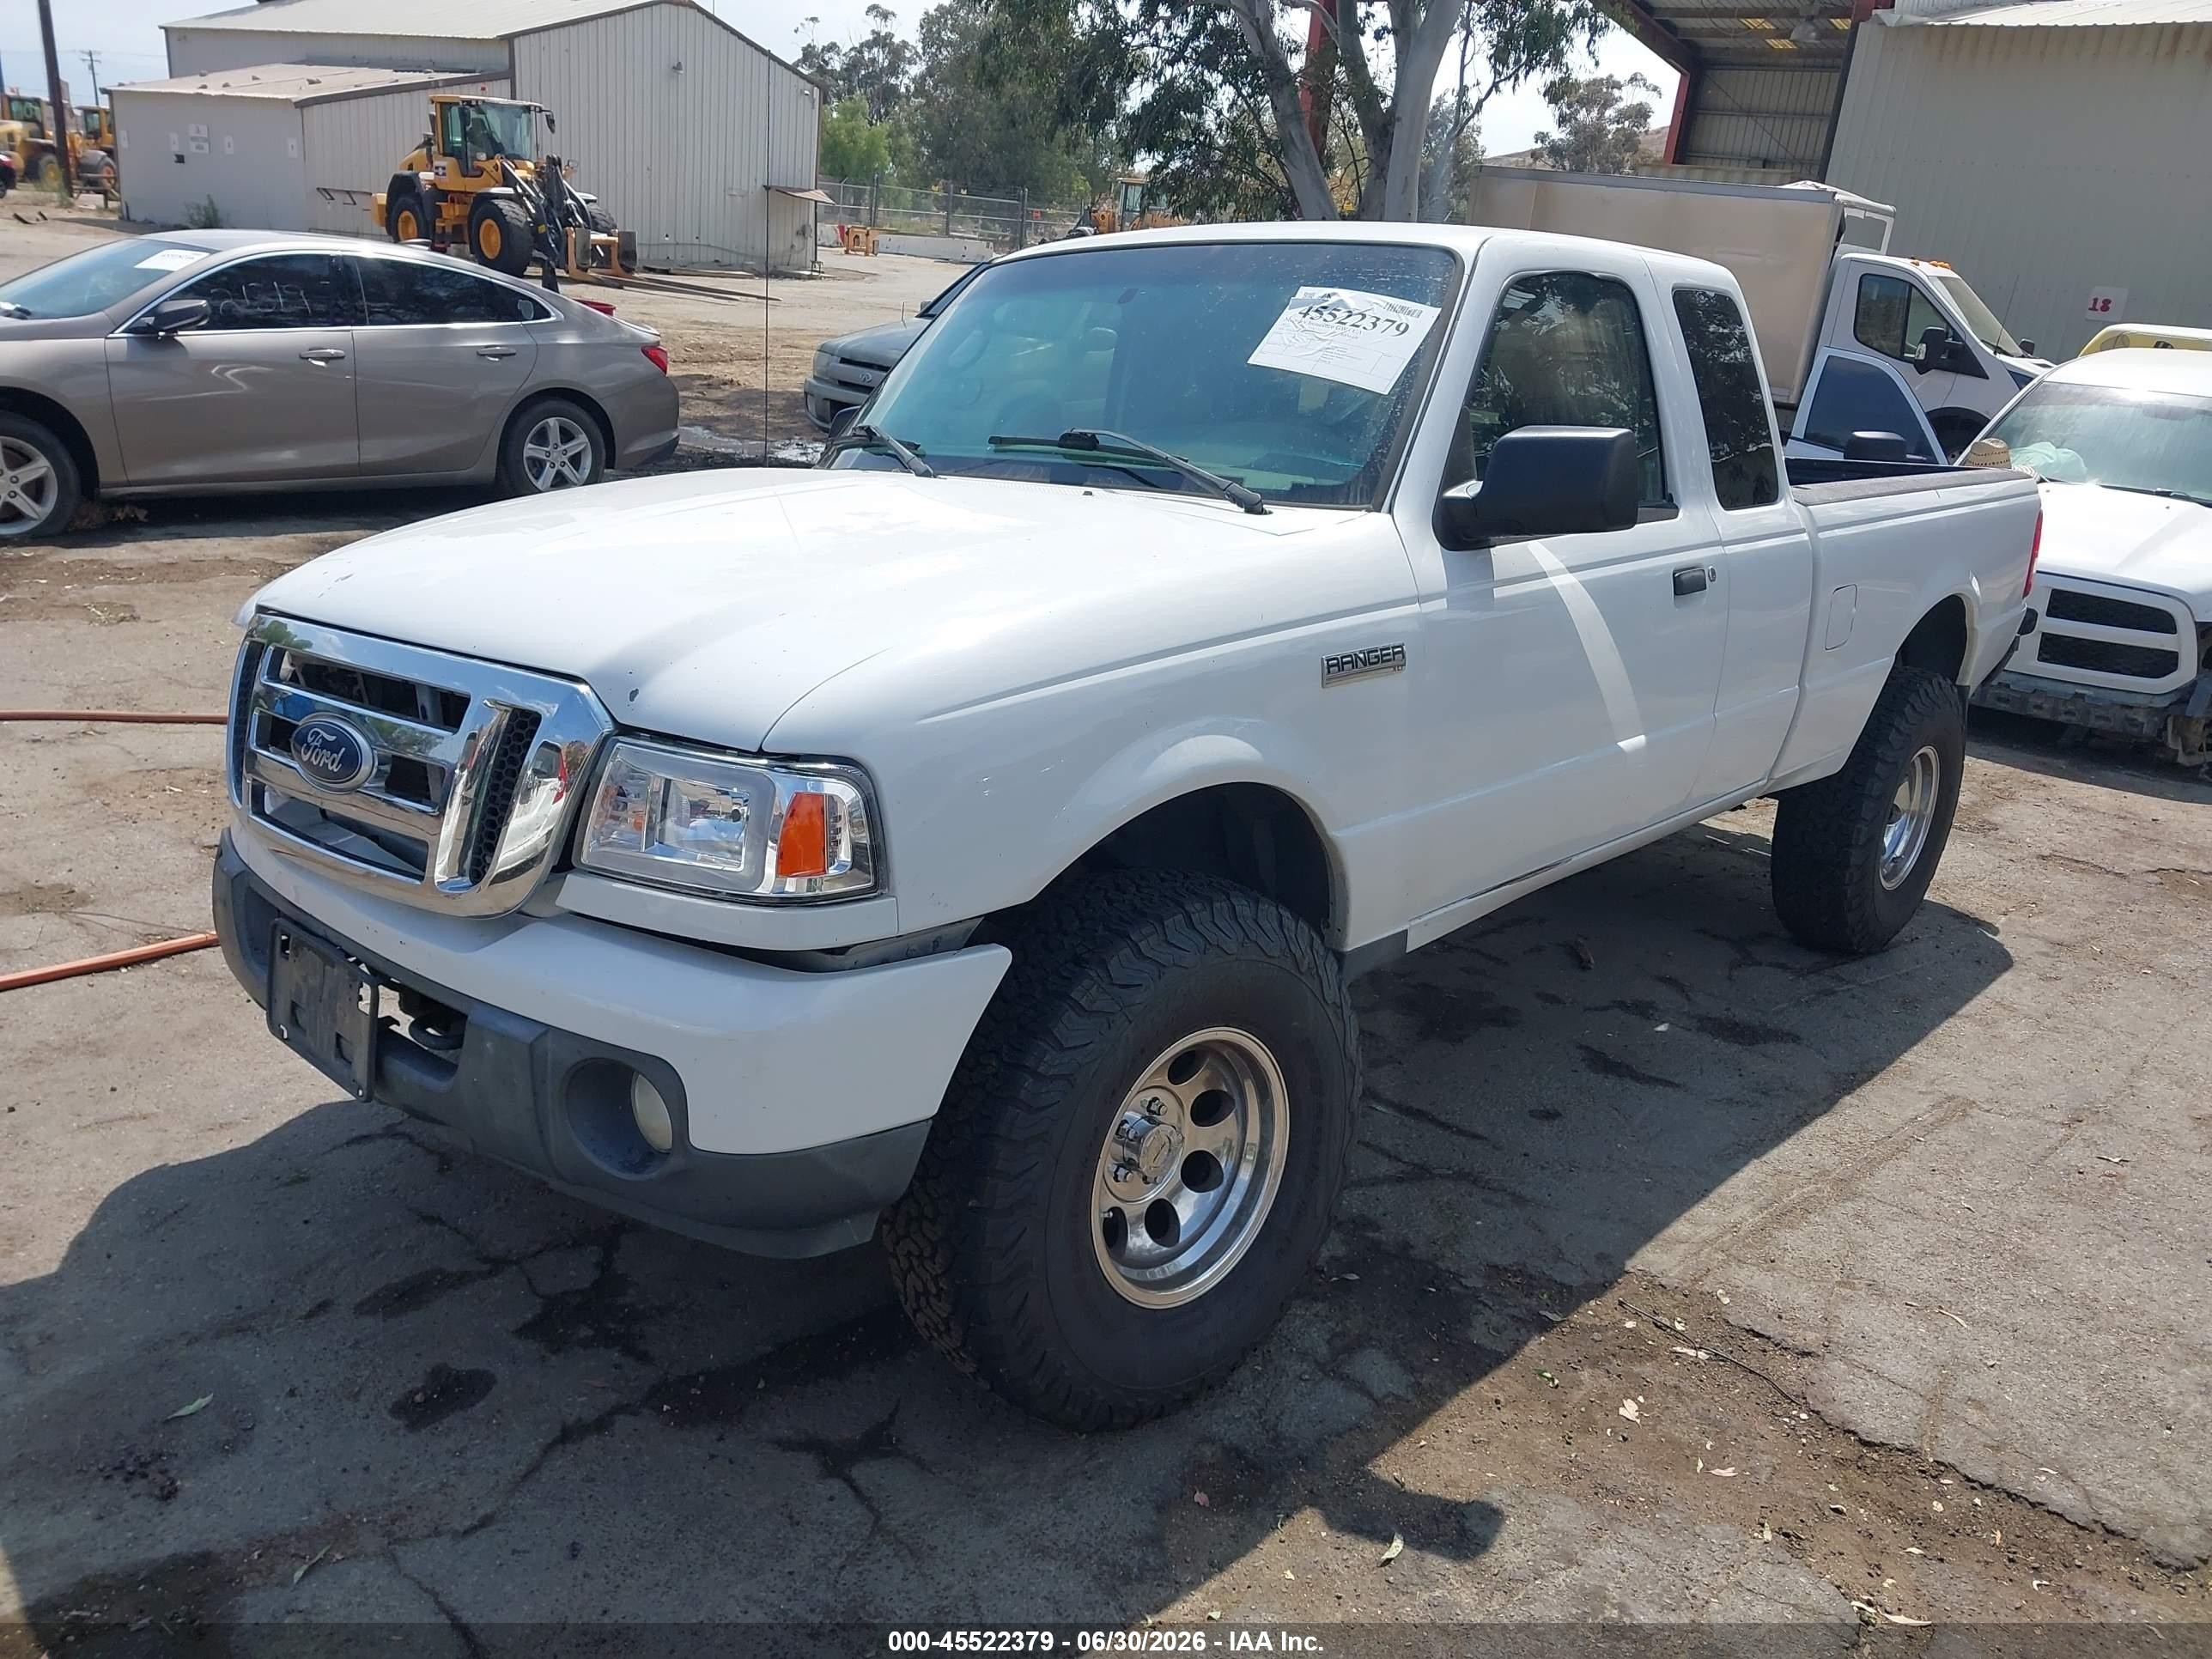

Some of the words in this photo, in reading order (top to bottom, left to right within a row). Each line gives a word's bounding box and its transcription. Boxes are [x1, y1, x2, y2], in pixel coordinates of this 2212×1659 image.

[2088, 297, 2112, 312] 18
[1297, 304, 1410, 337] 45522379
[1325, 644, 1406, 674] RANGER
[301, 727, 346, 772] Ford
